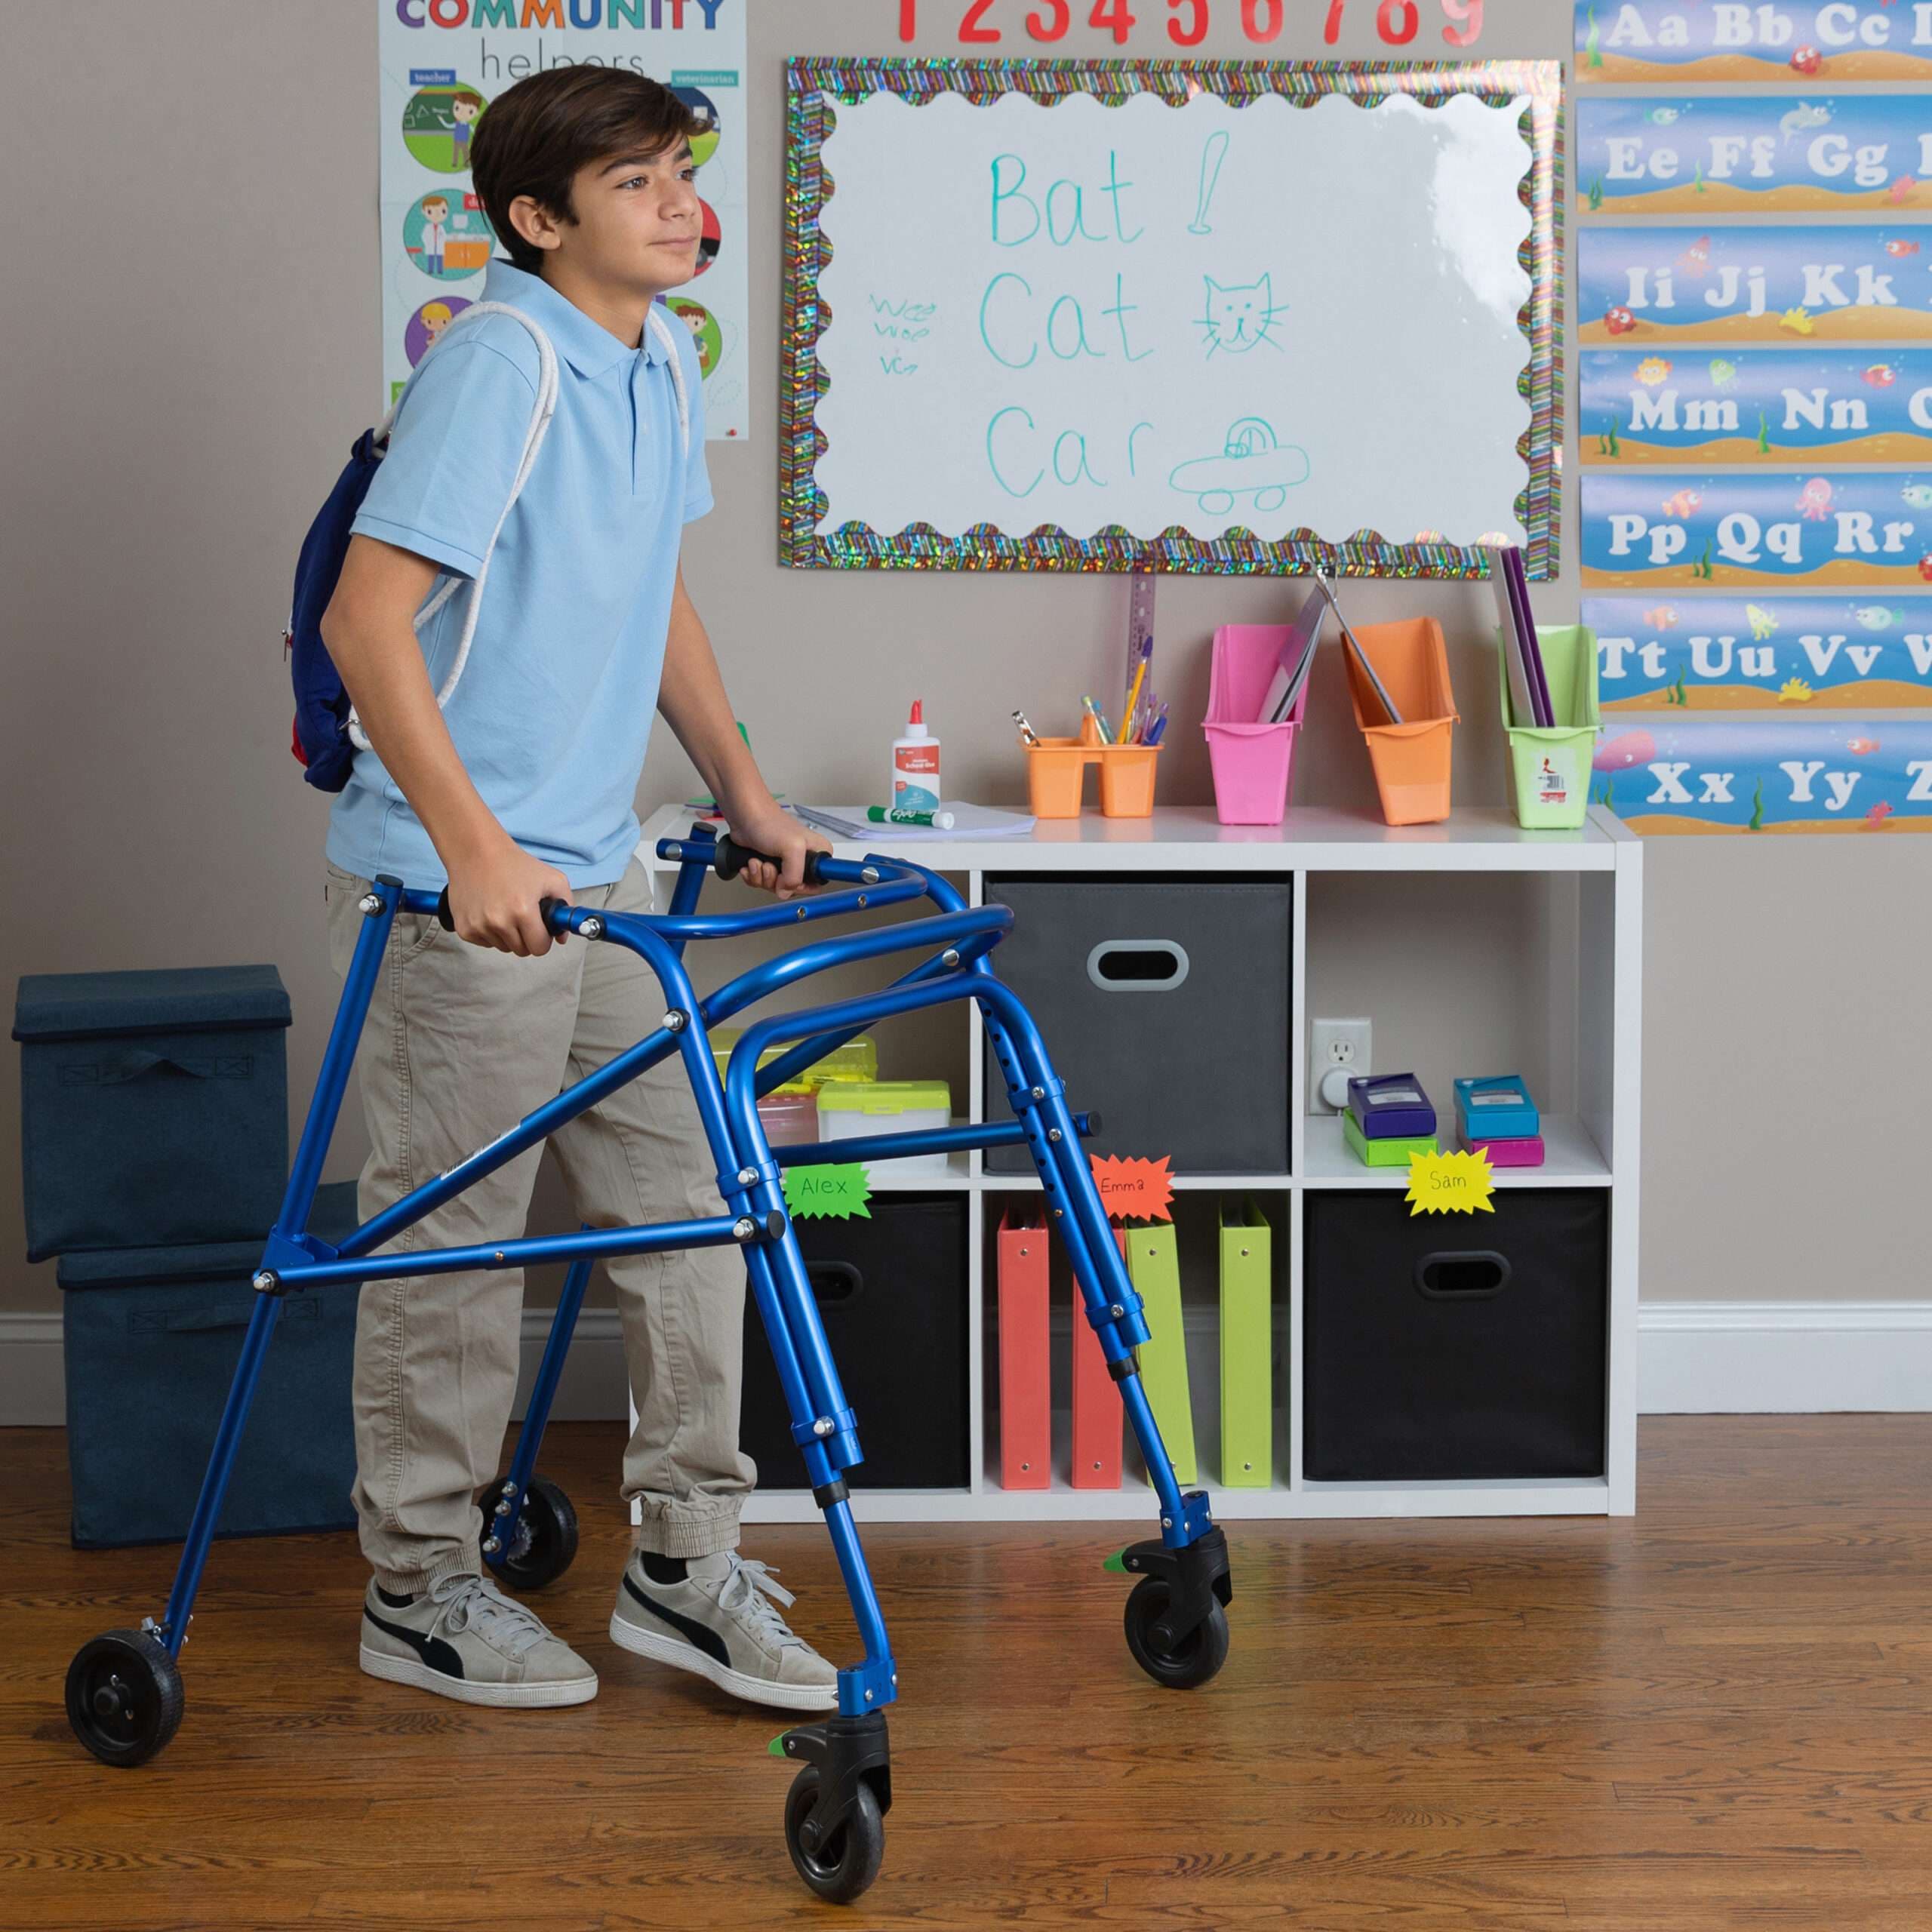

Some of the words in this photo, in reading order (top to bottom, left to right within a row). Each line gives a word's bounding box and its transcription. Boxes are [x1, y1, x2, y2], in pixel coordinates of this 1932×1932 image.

[397, 0, 724, 29] COMMUNITY
[1605, 4, 1688, 47] Aa
[1712, 3, 1793, 47] Bb
[1814, 3, 1890, 45] Cc
[1605, 137, 1679, 180] Ee
[1707, 135, 1777, 178] Ff
[1807, 134, 1888, 186] Gg
[989, 148, 1144, 249] Bat
[1626, 266, 1675, 309] Ii
[1704, 265, 1766, 318] Jj
[1802, 264, 1898, 306] Kk
[979, 271, 1155, 371] Cat
[1628, 389, 1739, 432] Mm
[1781, 388, 1869, 430] Nn
[985, 405, 1155, 499] Car
[1607, 515, 1687, 563] Pp
[1717, 512, 1803, 564] Qq
[1834, 512, 1915, 552] Rr
[1597, 637, 1666, 678] Tt
[1688, 636, 1777, 677] Uu
[1798, 635, 1882, 676] Vv
[1647, 762, 1735, 803] Xx
[1780, 761, 1861, 810] Yy
[801, 1177, 847, 1195] Alex
[1100, 1177, 1144, 1193] Emma
[1430, 1171, 1466, 1189] Sam
